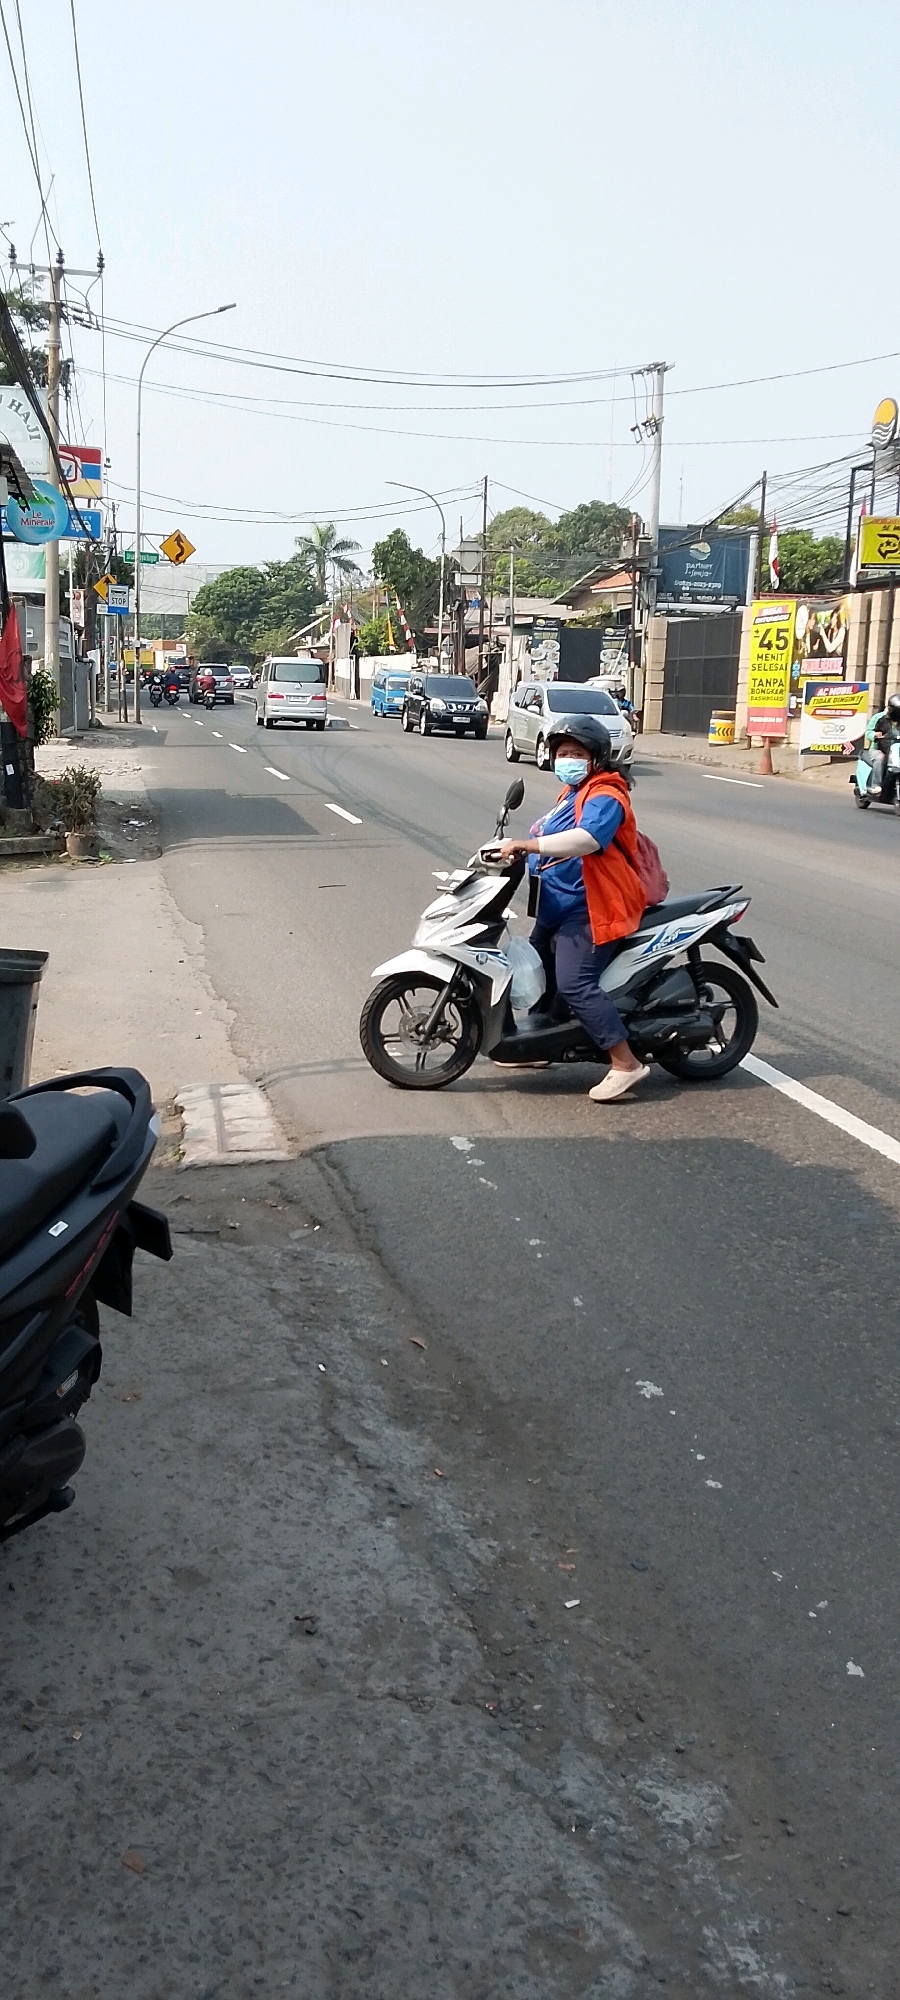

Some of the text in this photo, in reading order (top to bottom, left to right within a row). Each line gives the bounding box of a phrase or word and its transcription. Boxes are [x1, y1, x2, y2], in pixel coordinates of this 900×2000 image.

[7, 399, 41, 441] HAJI
[32, 510, 42, 518] Le
[21, 518, 55, 526] Minerale
[111, 597, 127, 605] STOP
[756, 653, 785, 662] MENIT
[751, 662, 788, 672] SELESAI
[751, 678, 785, 688] TANPA
[750, 687, 785, 696] BONGKAR
[816, 685, 854, 696] AC MOBIL
[809, 743, 843, 752] MASUK
[440, 931, 465, 942] HONDA
